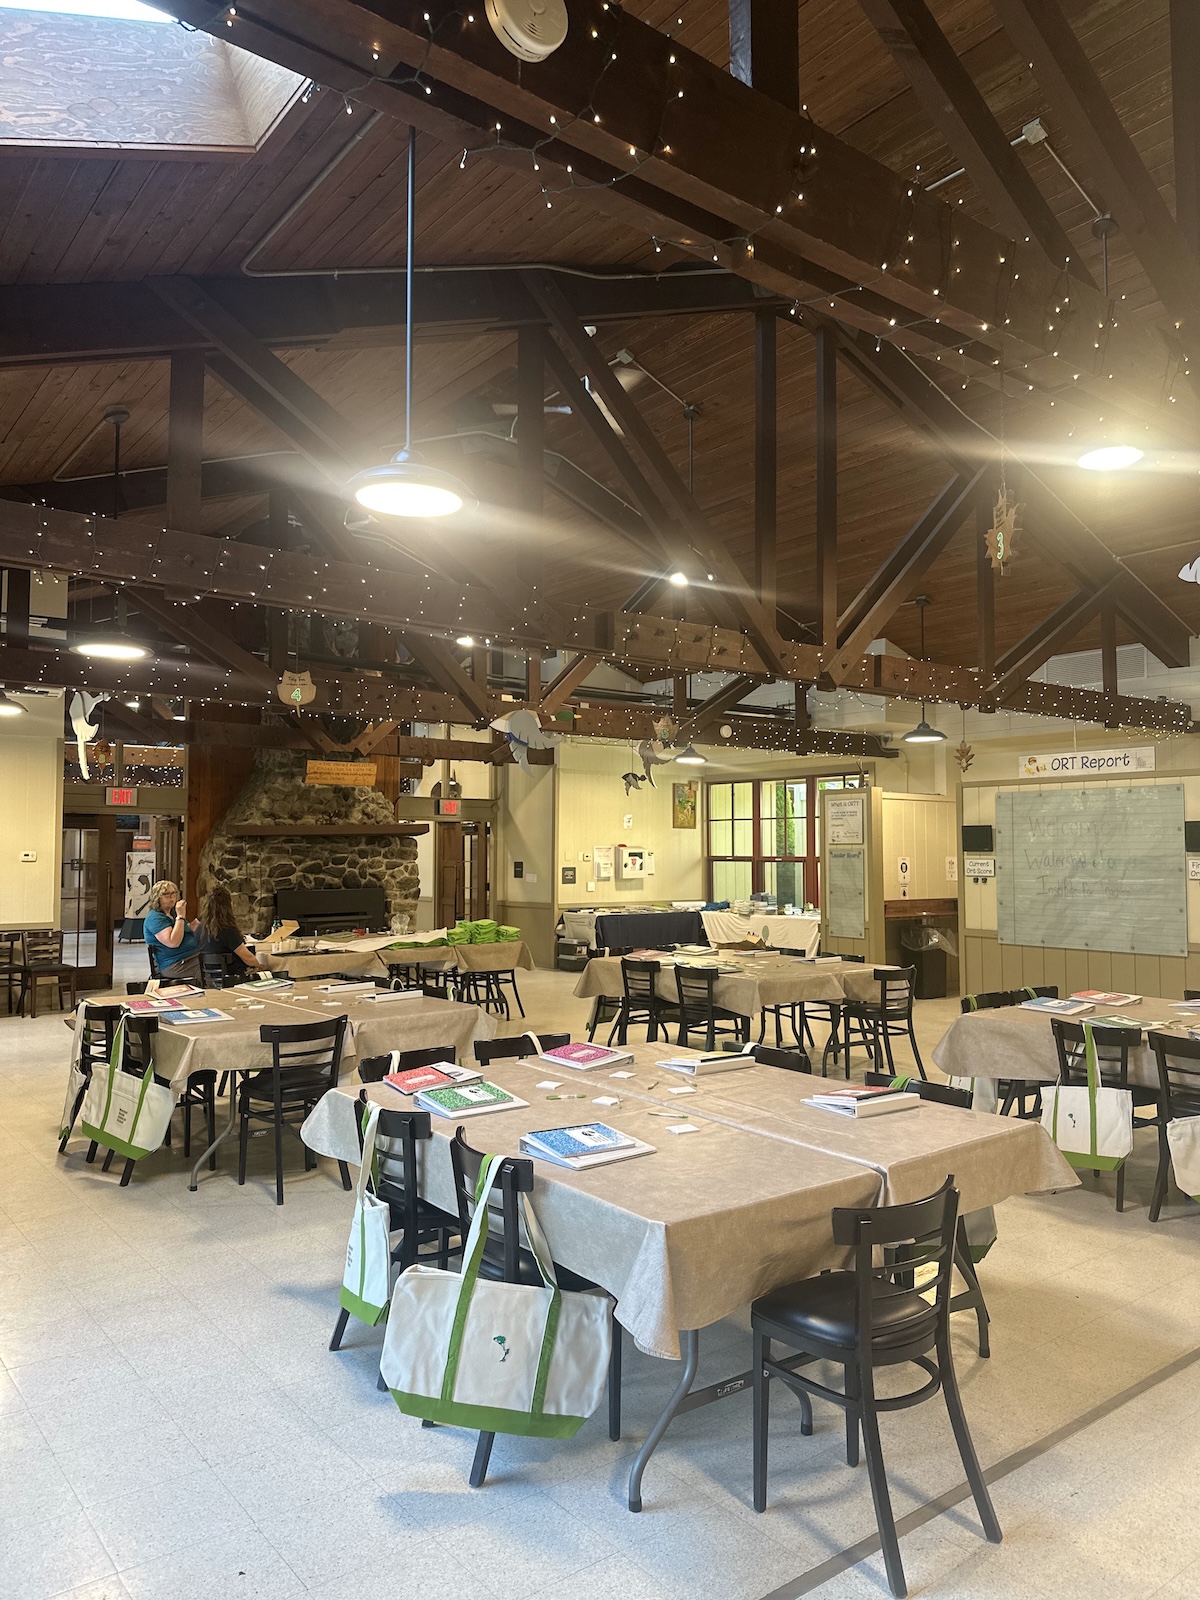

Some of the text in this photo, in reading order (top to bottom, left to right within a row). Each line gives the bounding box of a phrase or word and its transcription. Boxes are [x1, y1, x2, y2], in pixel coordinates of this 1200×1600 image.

[996, 532, 1004, 559] 3
[290, 688, 302, 701] 4
[1051, 753, 1130, 771] ORT Report
[112, 789, 133, 804] EXIT
